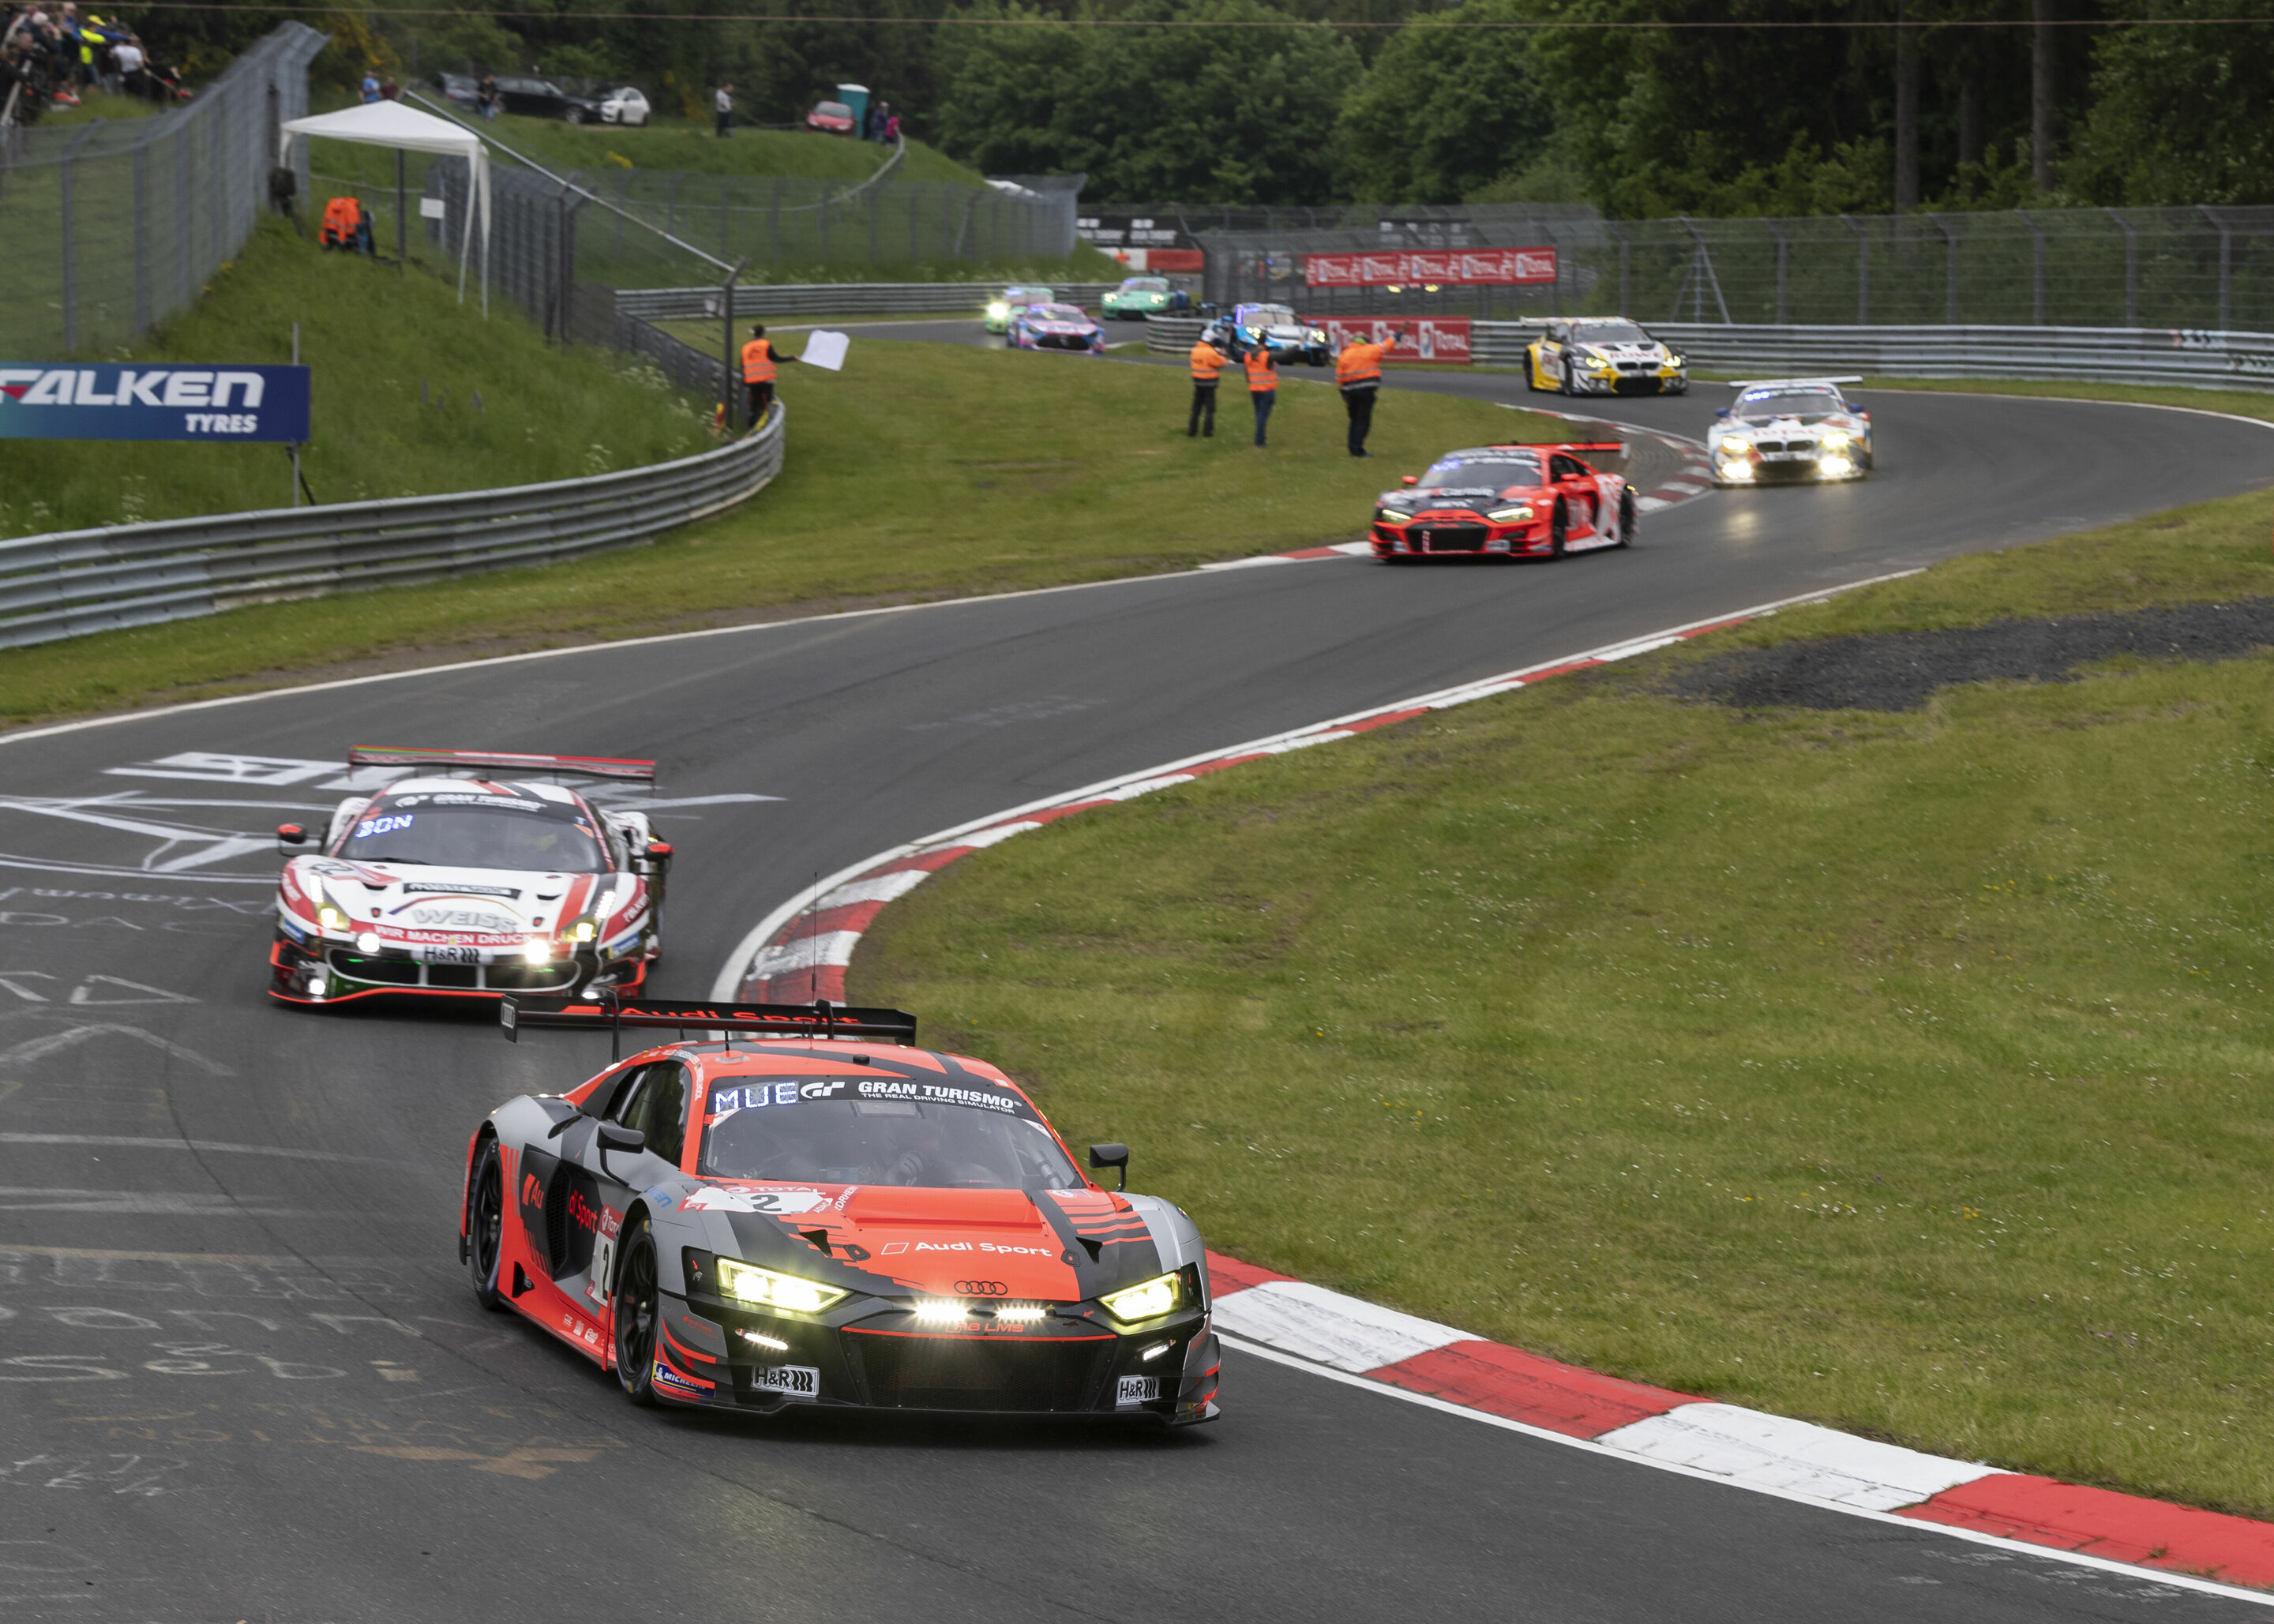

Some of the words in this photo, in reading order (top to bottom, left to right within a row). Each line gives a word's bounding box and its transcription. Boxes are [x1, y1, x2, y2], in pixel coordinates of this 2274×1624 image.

[185, 413, 258, 433] TYRES
[412, 909, 518, 934] WEISS
[373, 925, 405, 939] WIR
[407, 932, 475, 943] MACHEN
[715, 1082, 797, 1113] MUE
[858, 1081, 917, 1095] GRAN
[923, 1085, 1014, 1109] TURISMO
[914, 1095, 955, 1104] DRIVING
[958, 1099, 1015, 1115] SIMULATOR
[753, 1186, 826, 1195] TOTAL
[750, 1194, 782, 1212] 2
[576, 1195, 598, 1233] Sport
[914, 1242, 974, 1251] Audi
[979, 1243, 1053, 1257] Sport
[602, 1243, 610, 1301] 2
[955, 1322, 981, 1331] R8
[984, 1323, 1025, 1332] LMS
[756, 1367, 791, 1388] H&R
[1120, 1378, 1144, 1400] H&R
